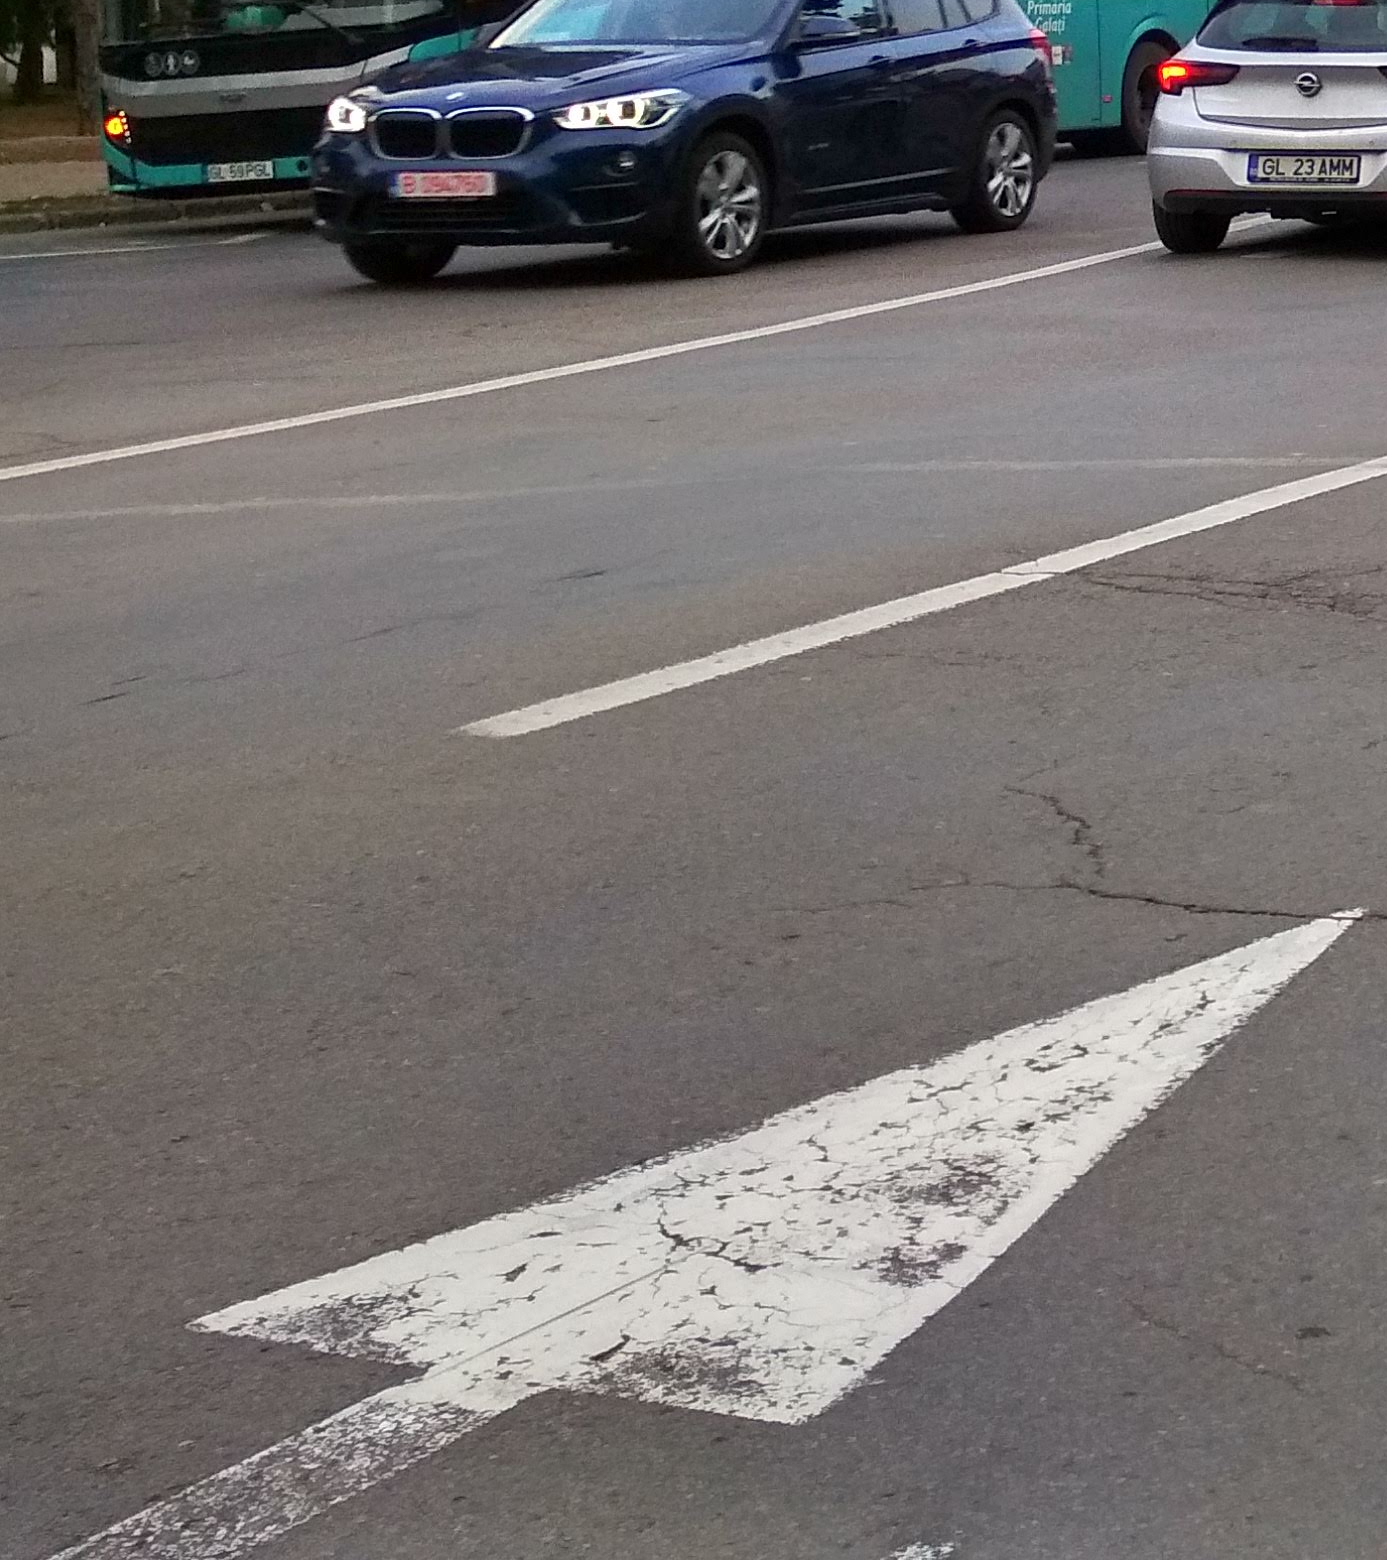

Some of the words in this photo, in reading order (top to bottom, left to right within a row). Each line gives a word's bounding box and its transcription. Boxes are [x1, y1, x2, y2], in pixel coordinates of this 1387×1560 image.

[1262, 158, 1285, 176] GL
[1293, 158, 1315, 176] 23
[1318, 158, 1353, 176] AMM
